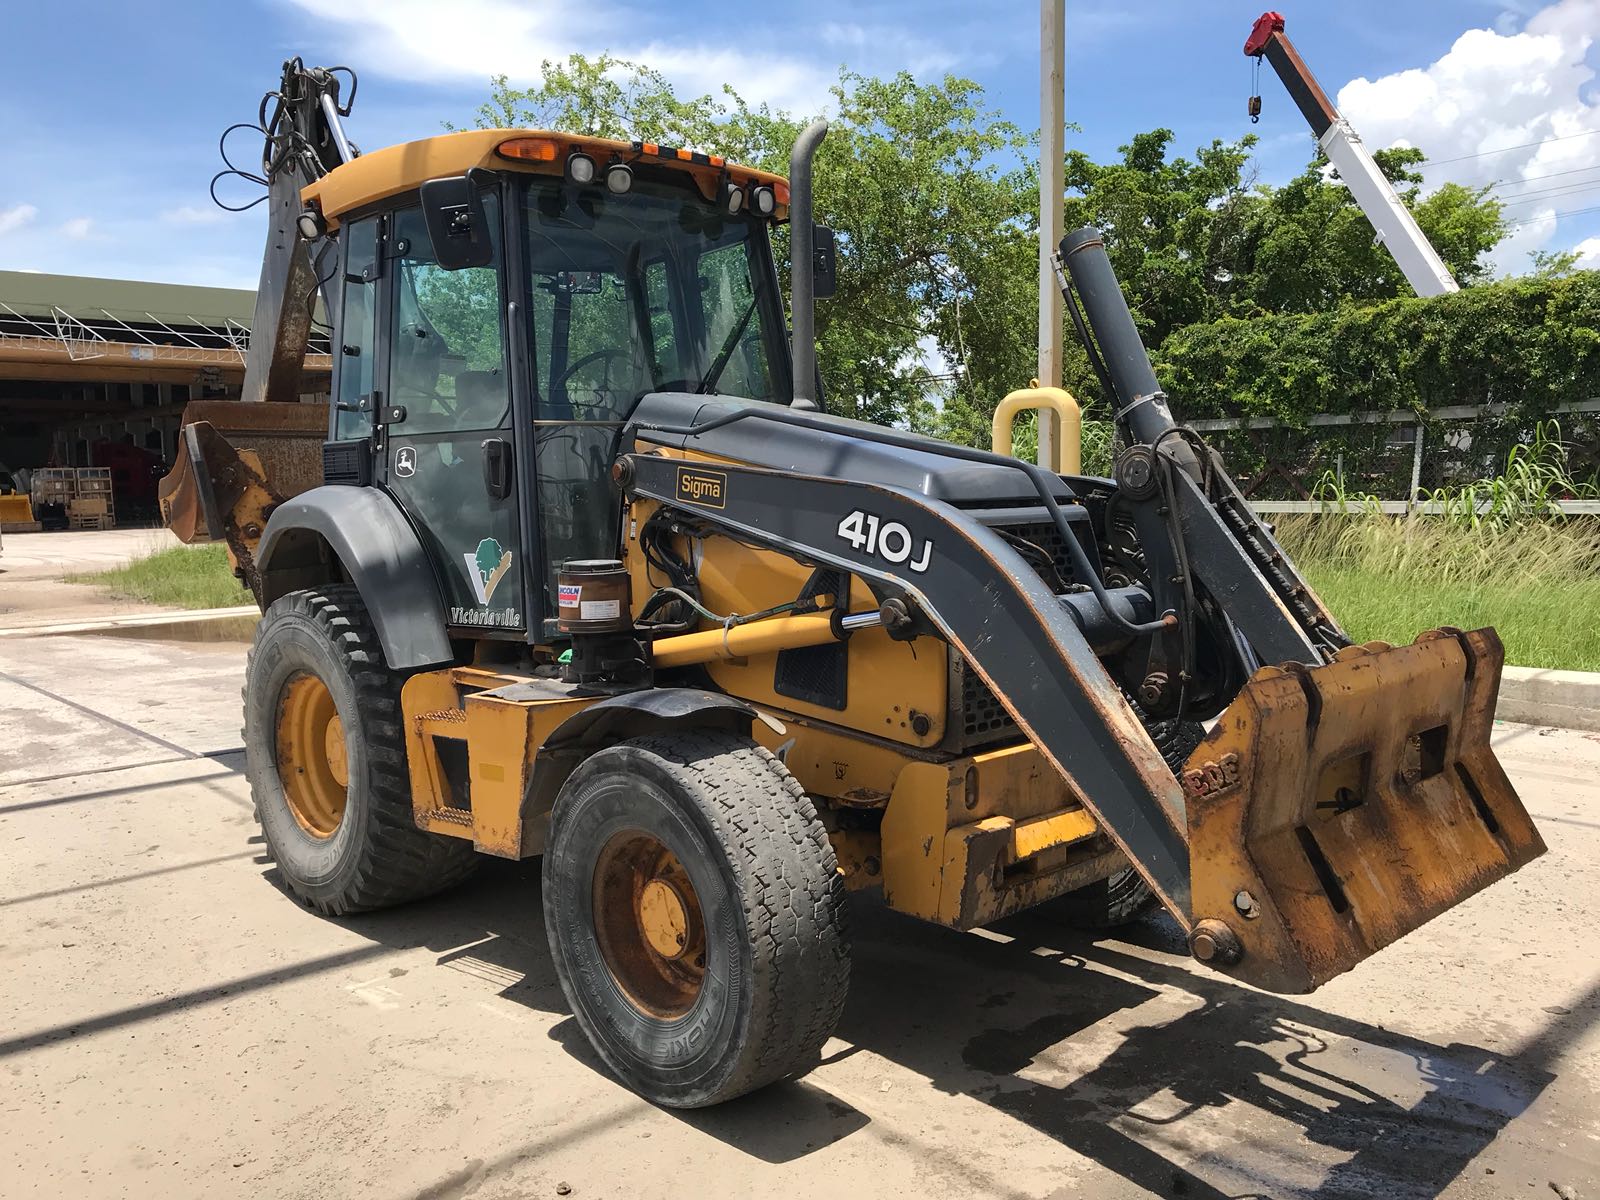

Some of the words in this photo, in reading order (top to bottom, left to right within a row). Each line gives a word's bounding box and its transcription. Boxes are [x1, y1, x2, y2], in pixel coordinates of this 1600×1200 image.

[681, 475, 721, 499] Sigma
[837, 510, 933, 572] 410J
[450, 606, 521, 627] Victoriaville
